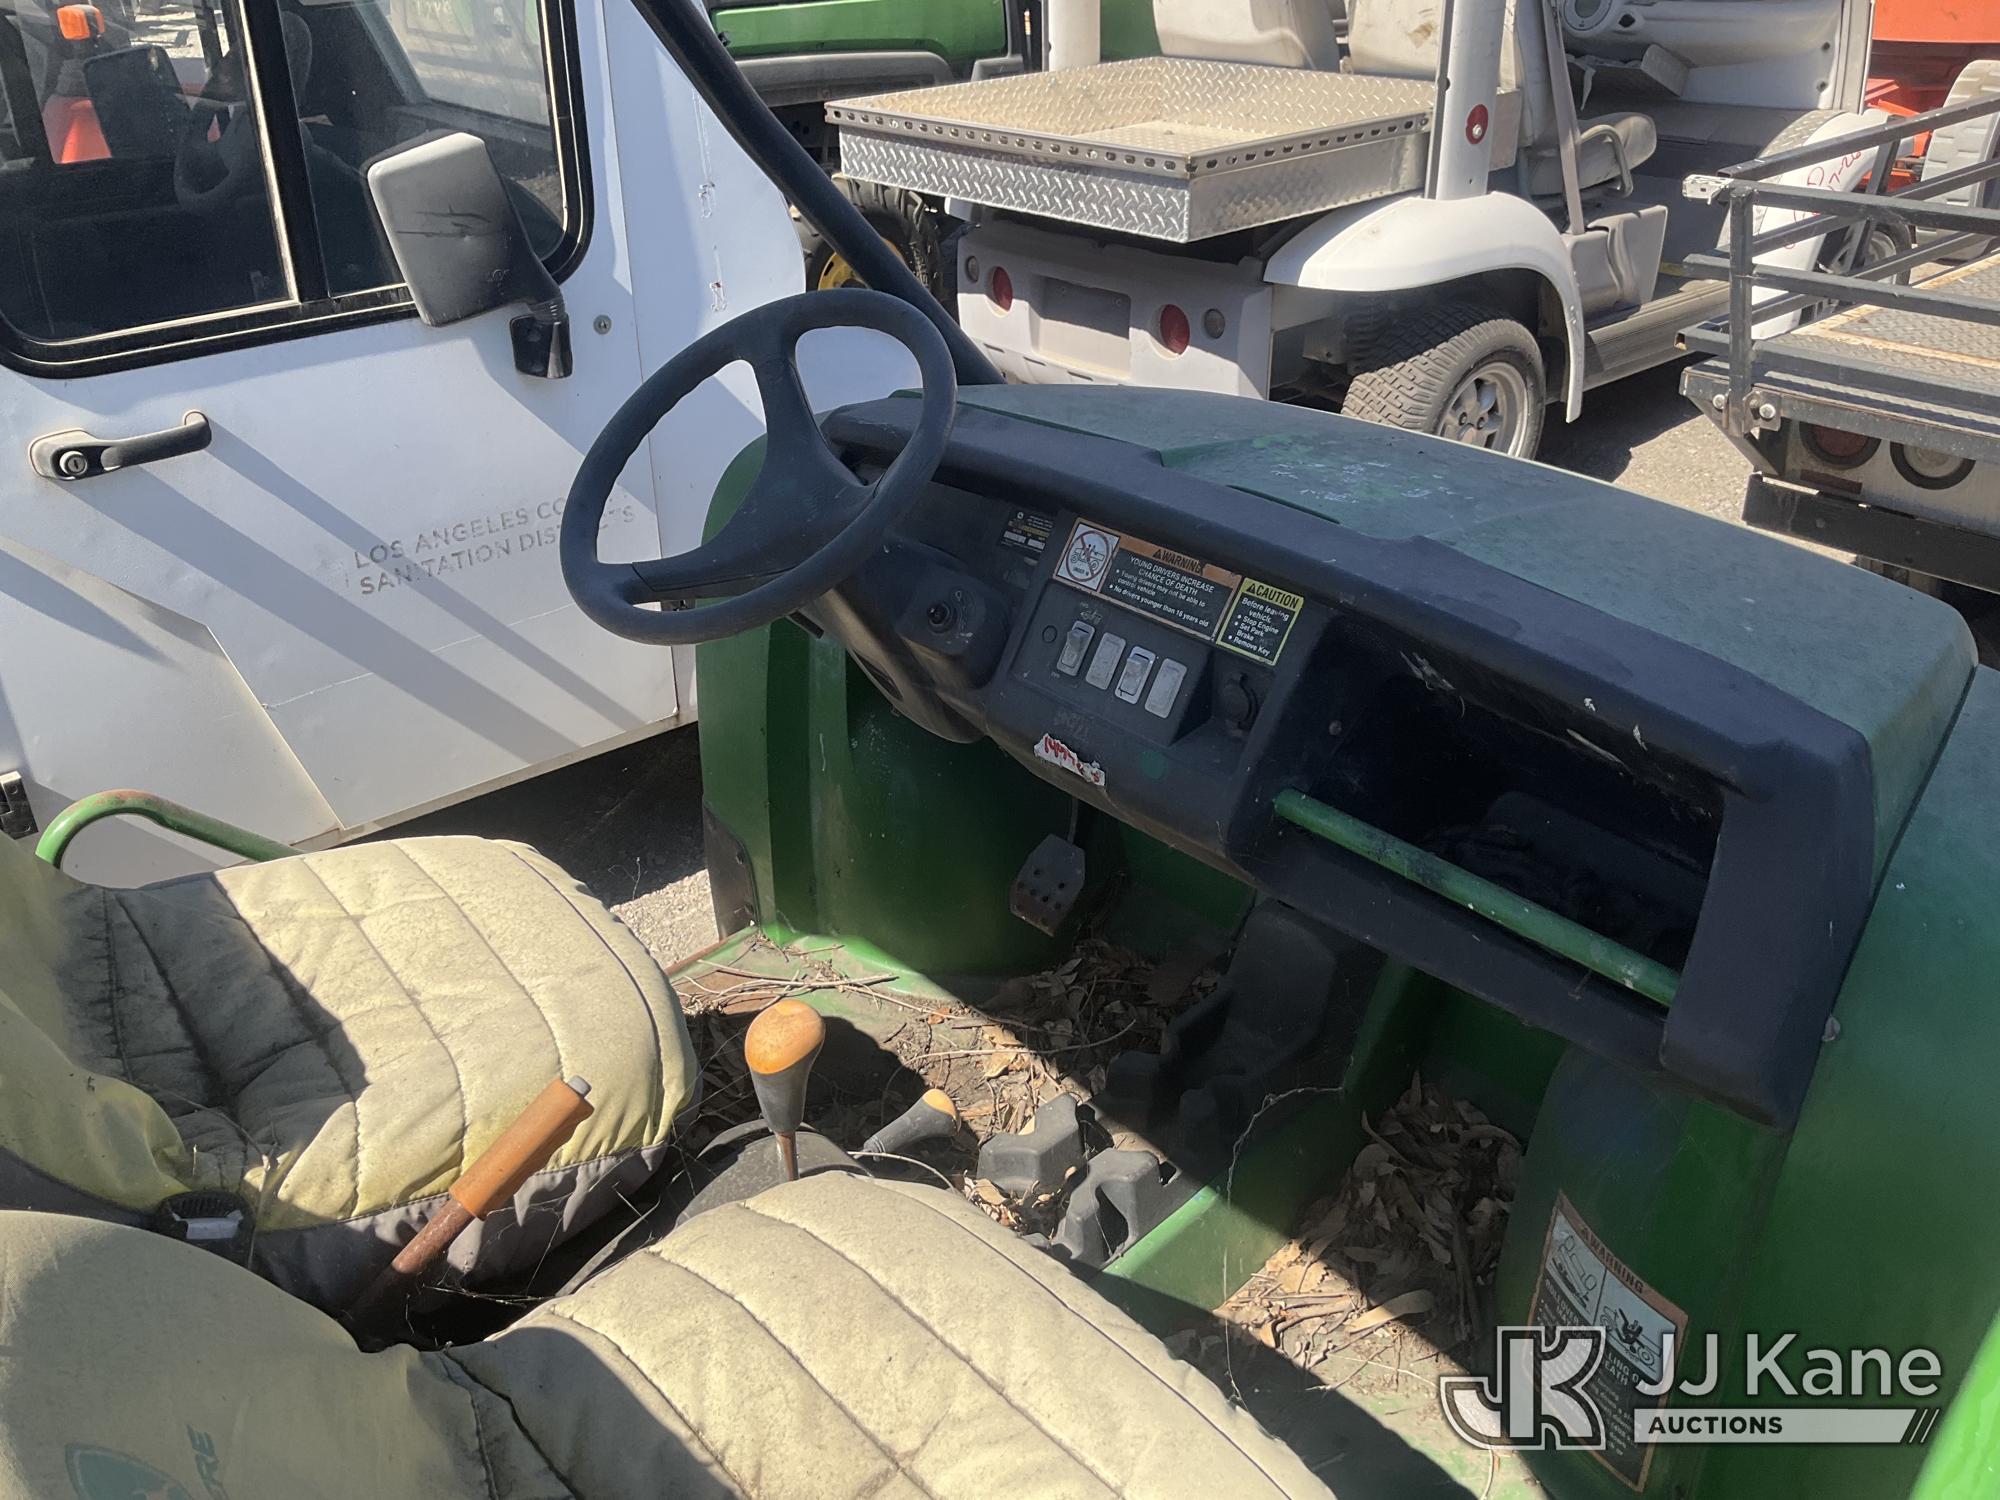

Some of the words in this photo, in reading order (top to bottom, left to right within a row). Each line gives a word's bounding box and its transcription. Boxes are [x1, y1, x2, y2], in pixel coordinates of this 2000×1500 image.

[354, 540, 404, 569] LOS
[415, 507, 528, 553] ANGELES
[1161, 549, 1203, 574] WARNING
[1130, 556, 1152, 570] YOUNG
[1152, 564, 1180, 580] DRIVERS
[1181, 575, 1215, 593] INCREASE
[1138, 568, 1165, 584] CHANCE
[1165, 578, 1175, 587] OF
[1174, 582, 1198, 596] DEATH
[1140, 597, 1162, 610] younger
[1162, 604, 1176, 614] than
[1241, 597, 1264, 611] Before
[1255, 584, 1300, 610] CAUTION
[1236, 629, 1254, 641] Brake
[1239, 622, 1250, 632] Set
[1250, 626, 1265, 637] Park
[1242, 615, 1258, 627] Stop
[1257, 621, 1279, 635] Engine
[1233, 636, 1258, 651] Remove
[1257, 645, 1271, 657] Key
